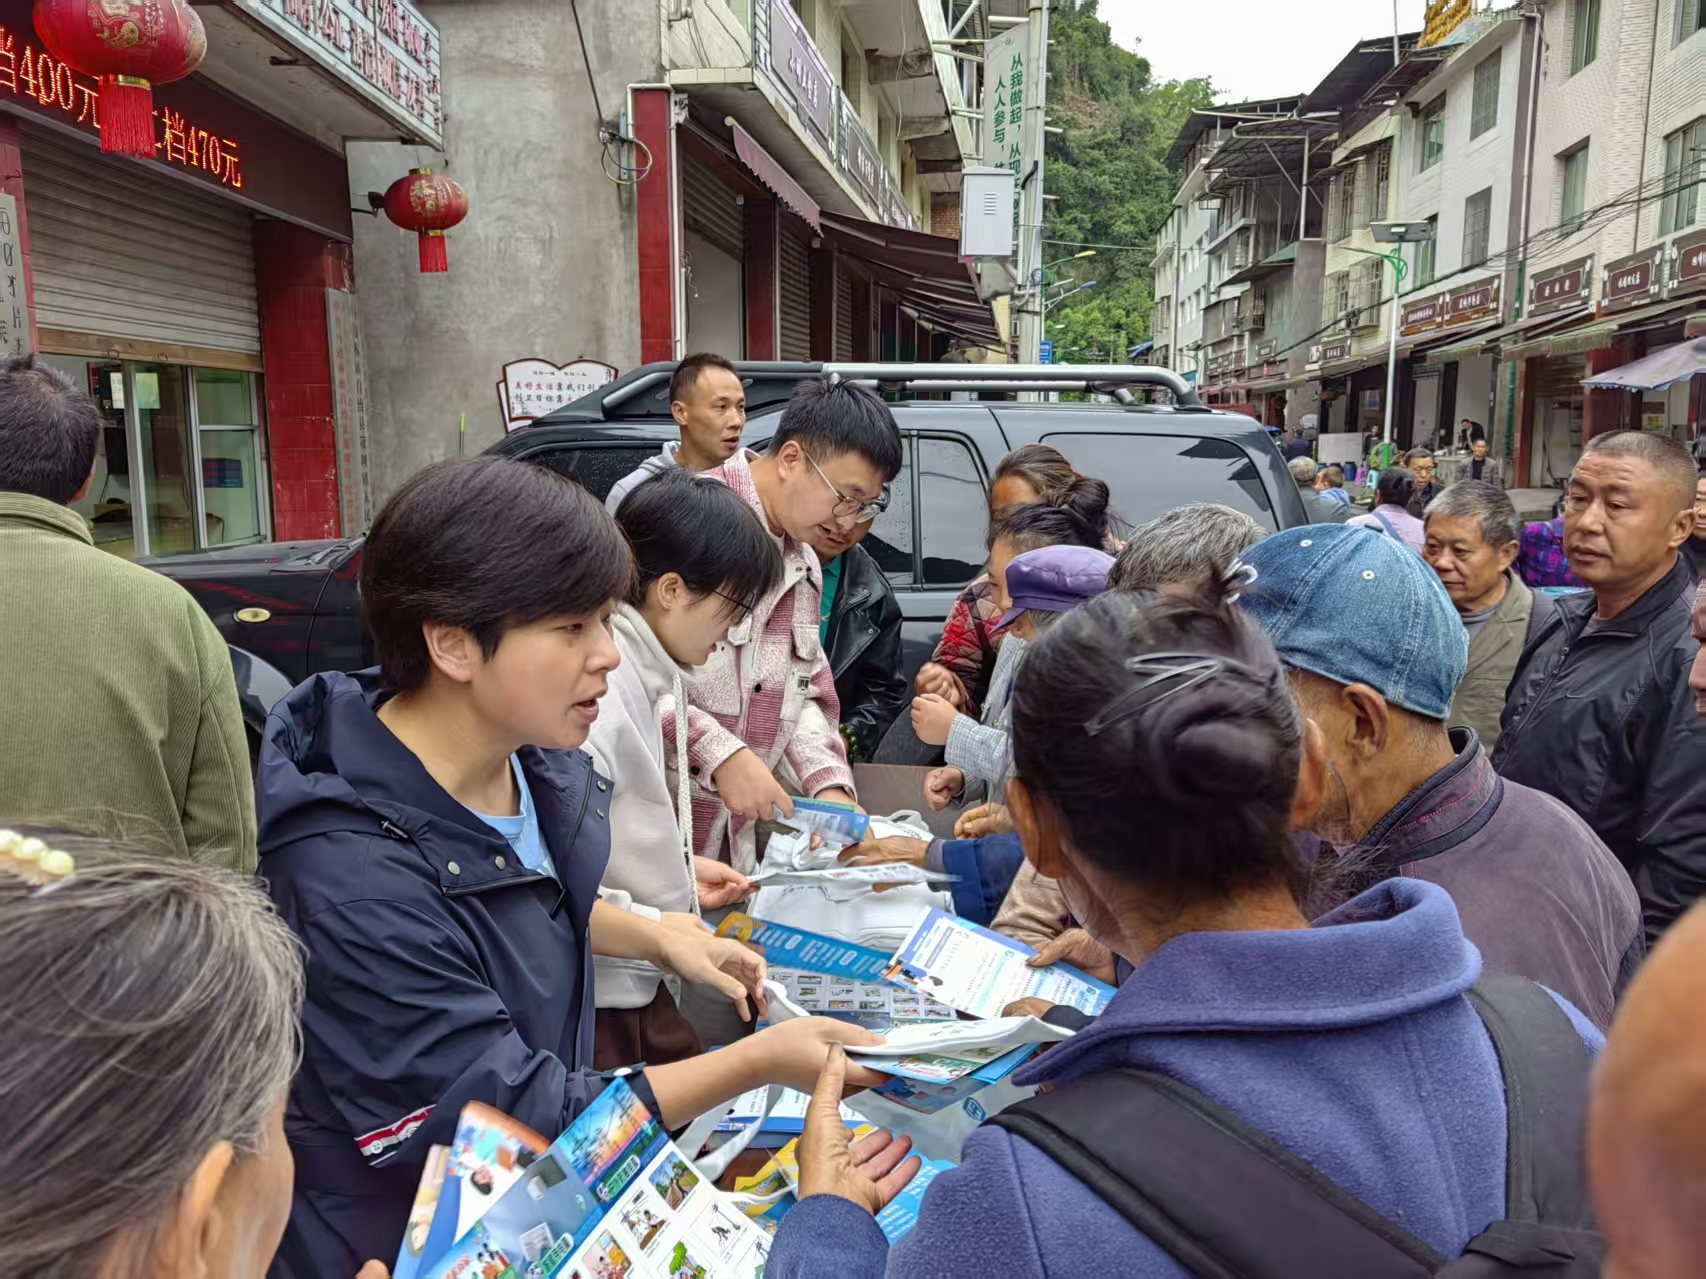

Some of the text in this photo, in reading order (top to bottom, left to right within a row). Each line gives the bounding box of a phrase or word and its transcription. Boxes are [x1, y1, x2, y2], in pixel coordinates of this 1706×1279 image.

[153, 106, 241, 187] 档470元
[514, 382, 601, 393] 美好生活靠我们创
